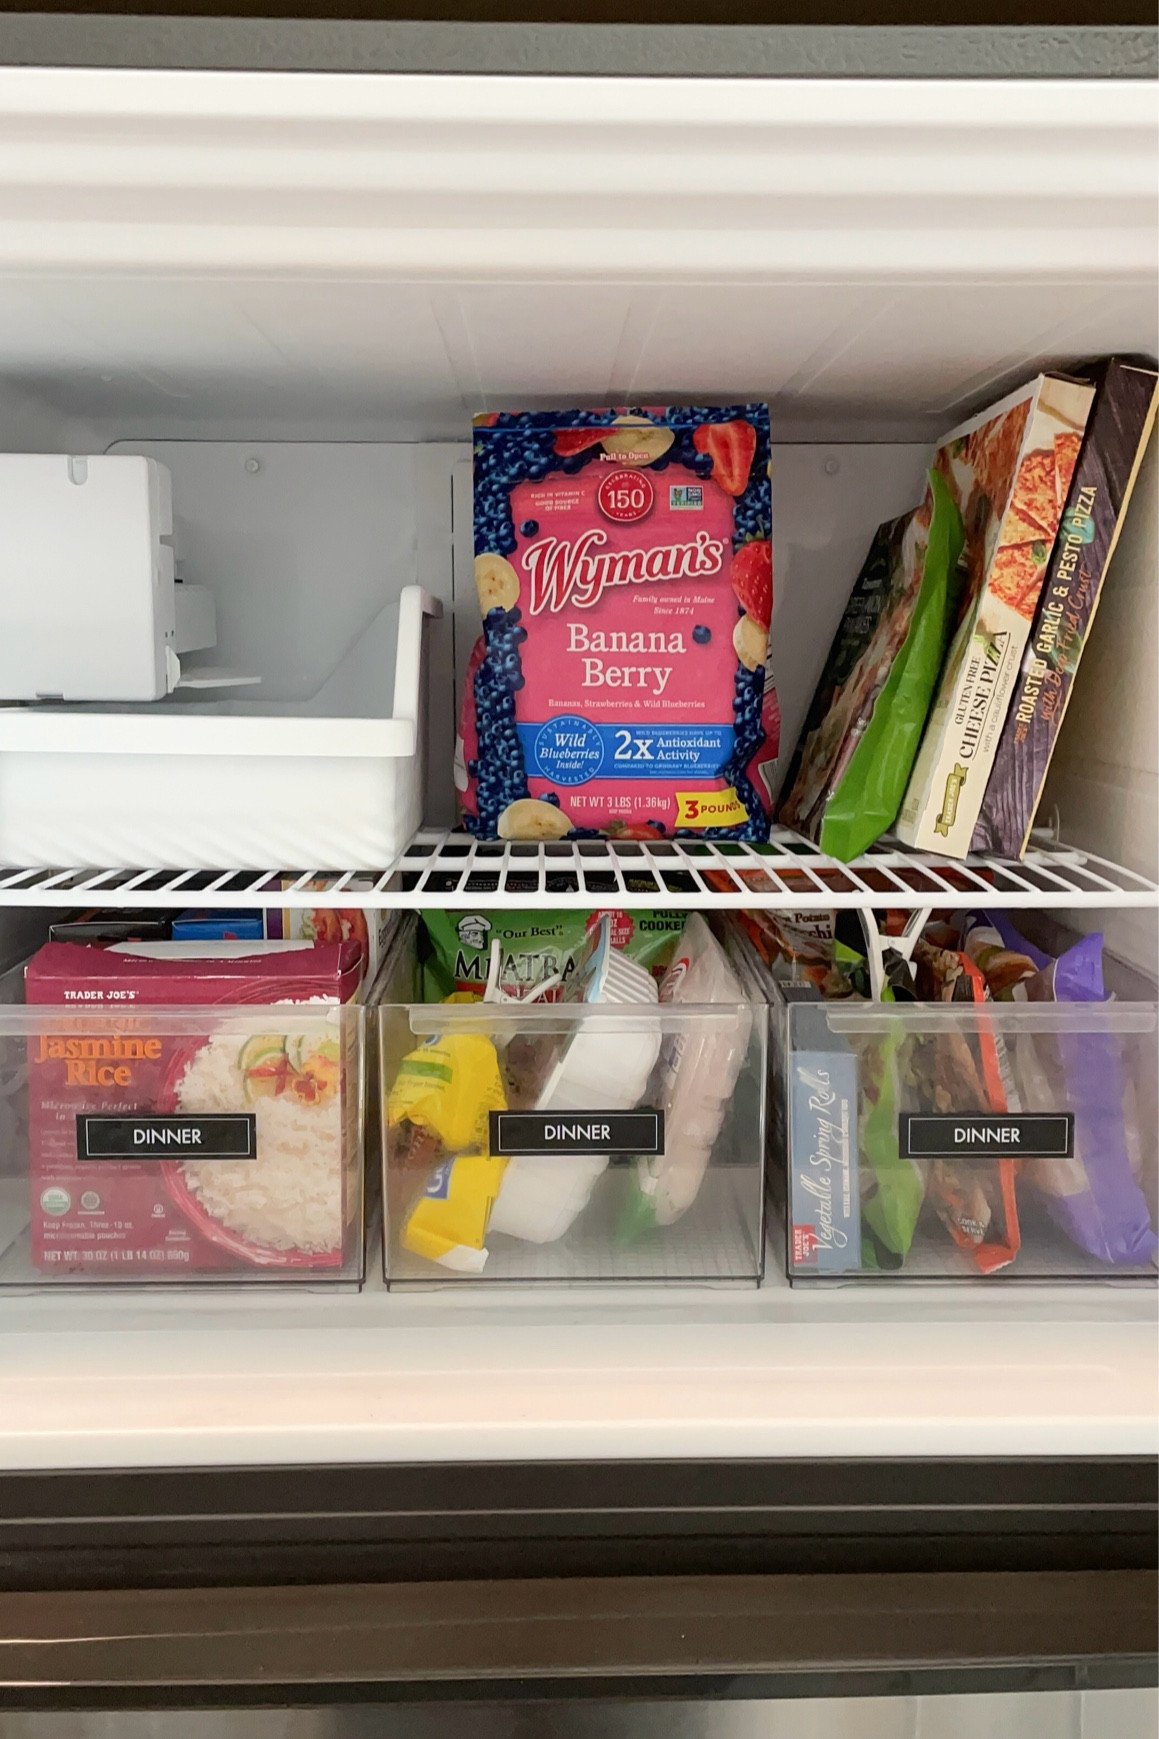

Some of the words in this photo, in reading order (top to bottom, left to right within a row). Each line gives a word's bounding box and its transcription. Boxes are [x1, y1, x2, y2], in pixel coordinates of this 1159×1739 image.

[600, 452, 616, 461] Pull
[618, 453, 627, 461] to
[628, 452, 649, 461] Open
[607, 489, 645, 509] 150
[1072, 486, 1098, 528] PIZZA
[1057, 534, 1083, 581] PESTO
[522, 529, 723, 615] Wyman's
[1053, 586, 1069, 598] &
[1068, 560, 1092, 610] Crust
[632, 595, 658, 604] Family
[692, 596, 715, 604] Maine
[653, 607, 673, 615] Since
[675, 607, 695, 615] 1874
[1036, 601, 1064, 654] GARLIC
[566, 623, 686, 653] Banana
[582, 658, 672, 695] Berry
[955, 684, 974, 725] GLUTEN
[967, 656, 981, 682] FREE
[959, 687, 991, 759] CHEESE
[979, 631, 1008, 687] PIZZA
[983, 735, 993, 753] with
[991, 673, 1009, 722] cauliflower
[1007, 646, 1018, 671] crust
[1016, 658, 1048, 724] ROASTED
[548, 699, 583, 709] Bananas,
[584, 699, 633, 708] Strawberries
[634, 700, 641, 708] &
[643, 700, 660, 708] Wild
[662, 700, 705, 708] Blueberries
[554, 733, 587, 748] Wild
[614, 730, 654, 760] 2x
[656, 737, 721, 749] Antioxidant
[539, 748, 600, 760] Blueberries
[656, 750, 700, 763] Activity
[556, 760, 585, 769] Inside!
[570, 796, 586, 807] NET
[589, 796, 604, 807] WT
[607, 796, 613, 808] 3
[615, 796, 632, 808] LBS
[634, 796, 671, 810] (1.36kg)
[685, 800, 699, 819] 3
[701, 801, 741, 814] POUNDS
[640, 920, 686, 931] COOKE
[64, 991, 104, 1000] TRADER
[106, 990, 136, 1000] JOE'S
[34, 1034, 162, 1064] Jasmine
[65, 1059, 132, 1086] Rice
[797, 1066, 836, 1115] Rolls
[133, 1129, 202, 1145] DINNER
[544, 1124, 610, 1141] DINNER
[954, 1127, 1020, 1143] DINNER
[810, 1117, 845, 1172] Spring
[800, 1174, 848, 1252] Vegetable
[44, 1251, 62, 1261] NET
[95, 1251, 108, 1261] OZ
[121, 1251, 133, 1261] LB
[136, 1250, 147, 1261] 14
